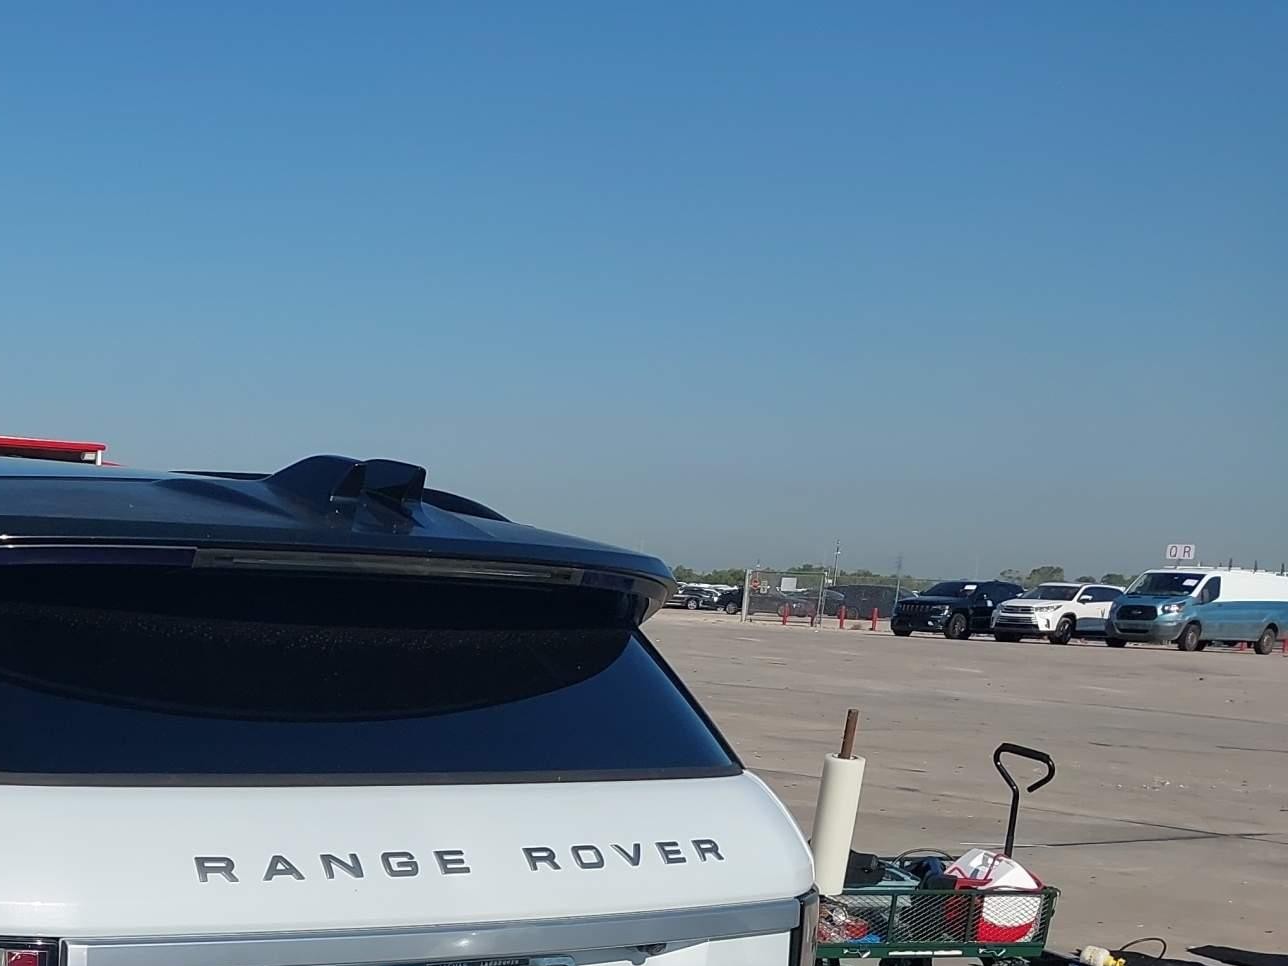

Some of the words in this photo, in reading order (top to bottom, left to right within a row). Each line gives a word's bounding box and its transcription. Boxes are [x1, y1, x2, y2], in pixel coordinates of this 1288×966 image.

[1183, 545, 1192, 558] R
[194, 850, 472, 883] RANGE
[522, 838, 725, 871] ROVER
